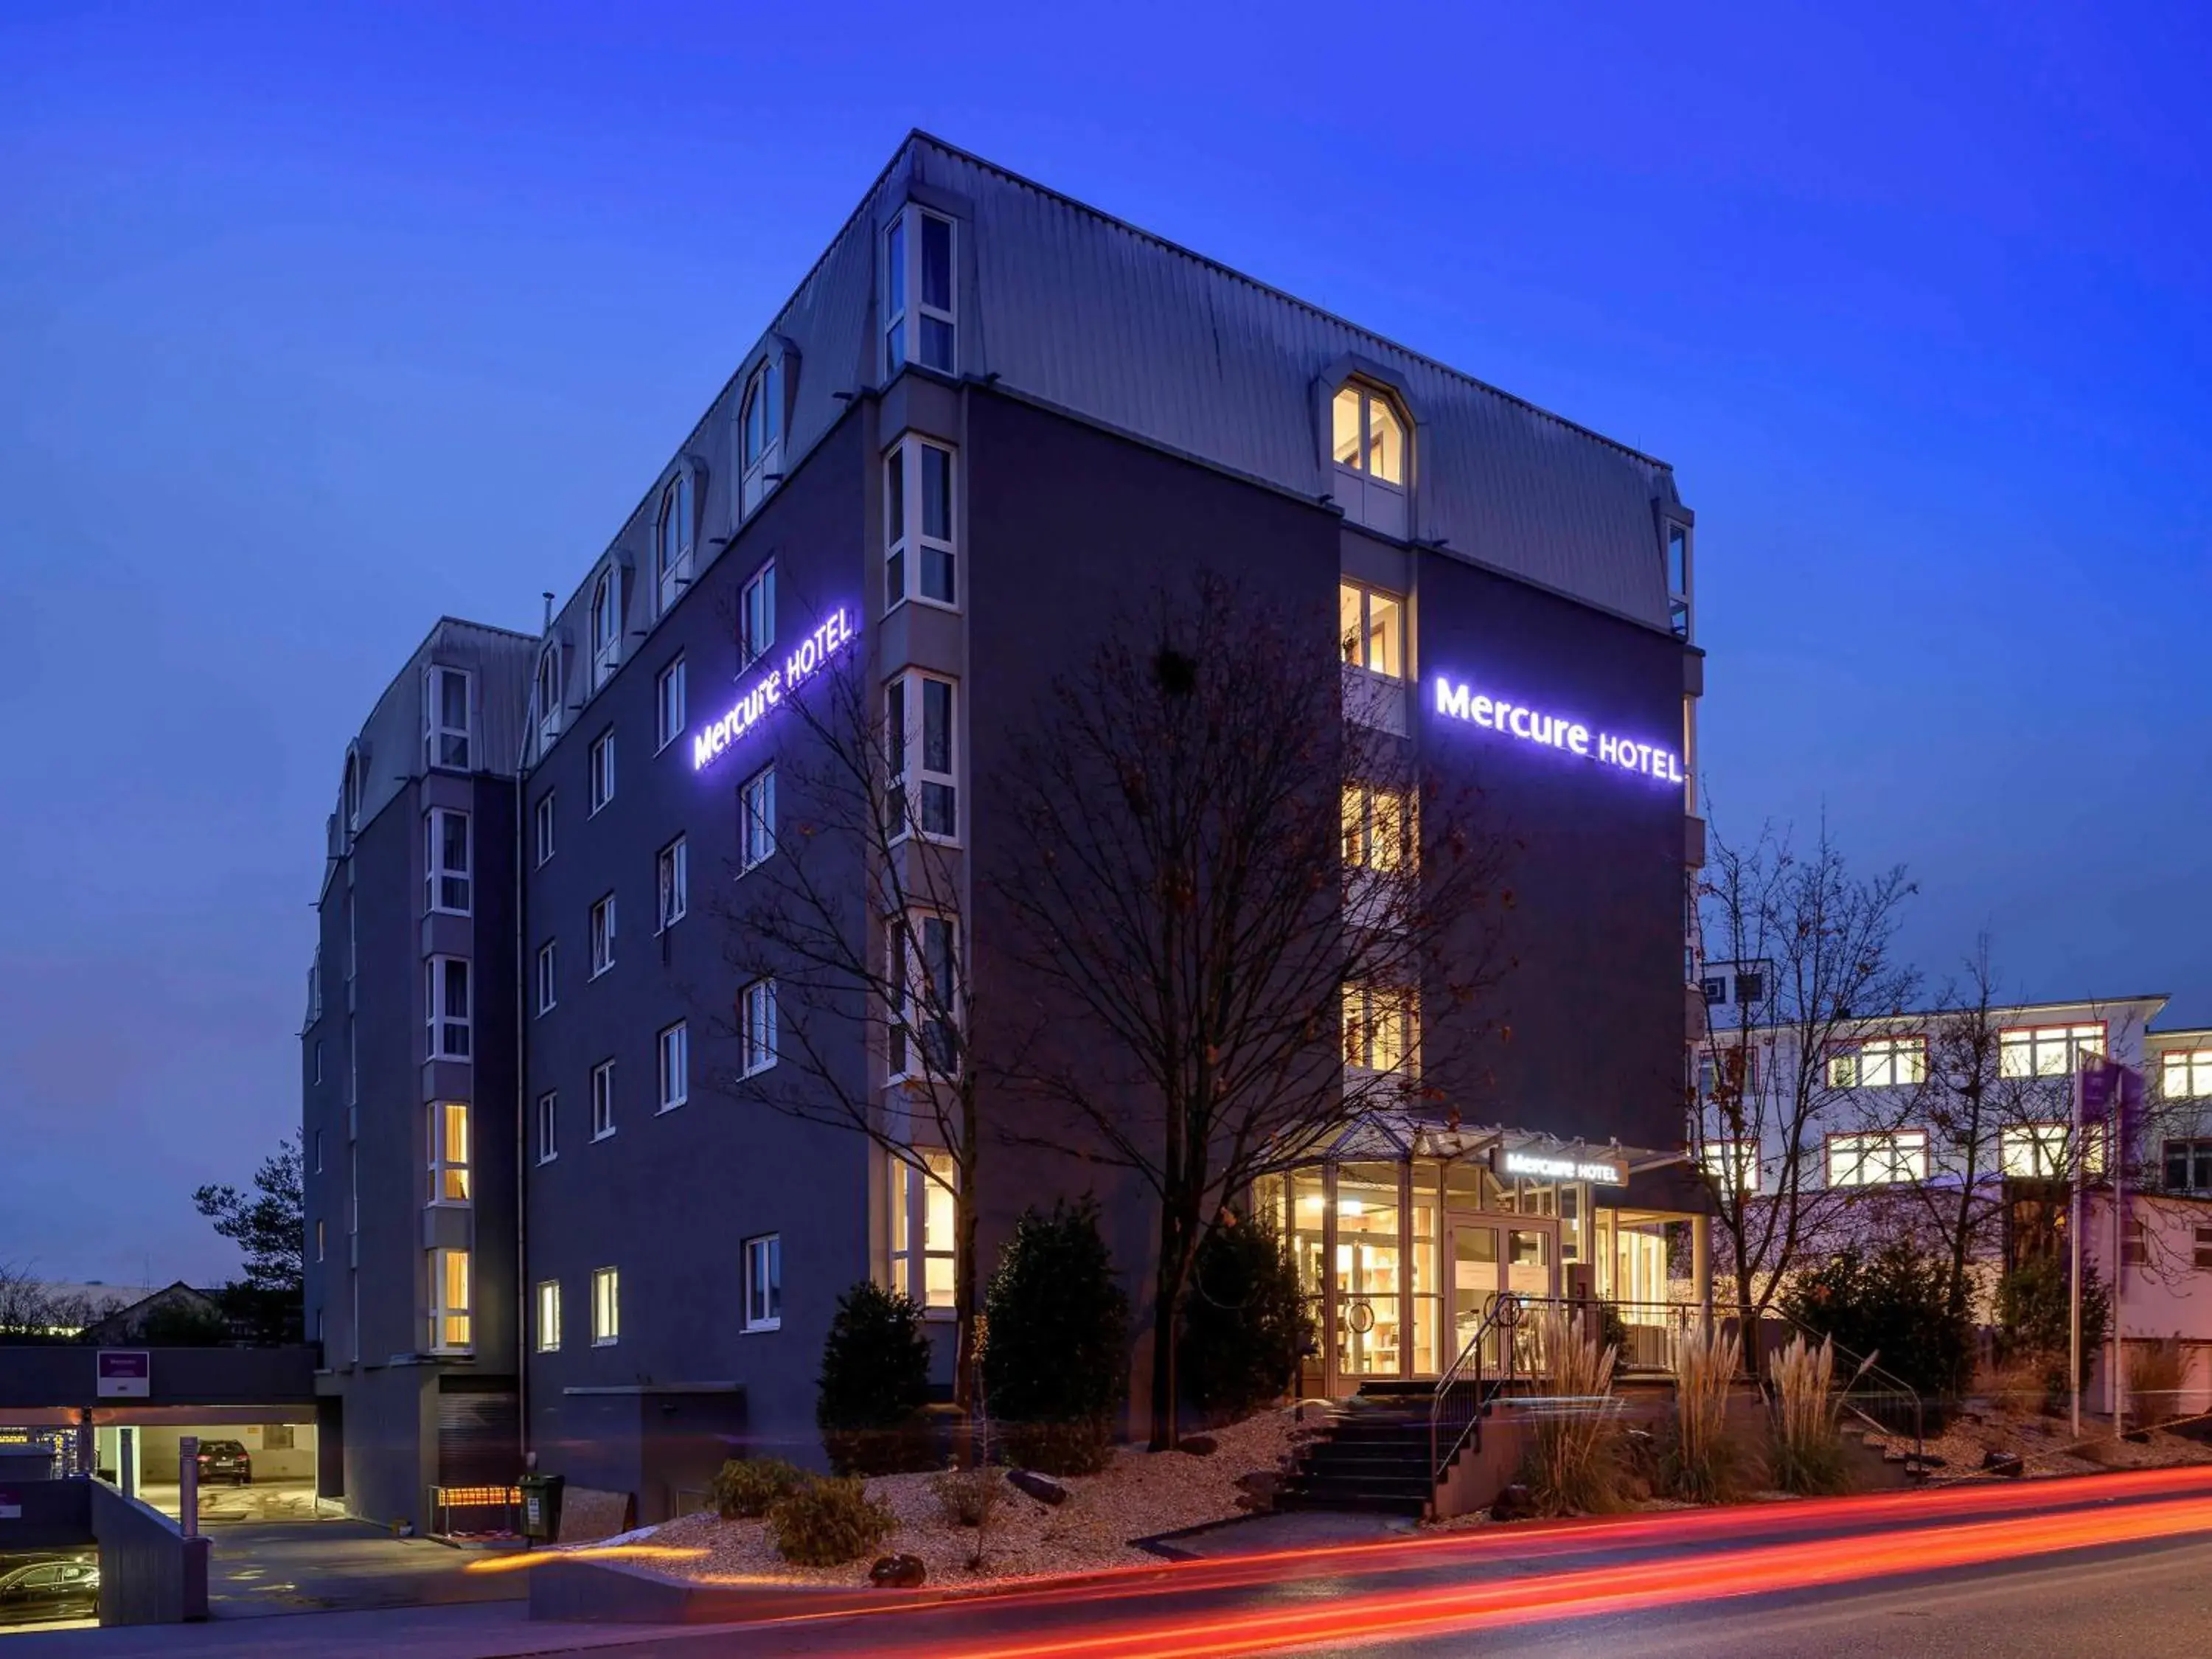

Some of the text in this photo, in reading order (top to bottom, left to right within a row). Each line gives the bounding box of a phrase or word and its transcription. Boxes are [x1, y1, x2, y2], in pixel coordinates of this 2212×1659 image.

[692, 607, 852, 770] Mercure HOTEL
[1436, 678, 1683, 783] Mercure HOTEL
[1506, 1153, 1618, 1181] Mercure HOTEL
